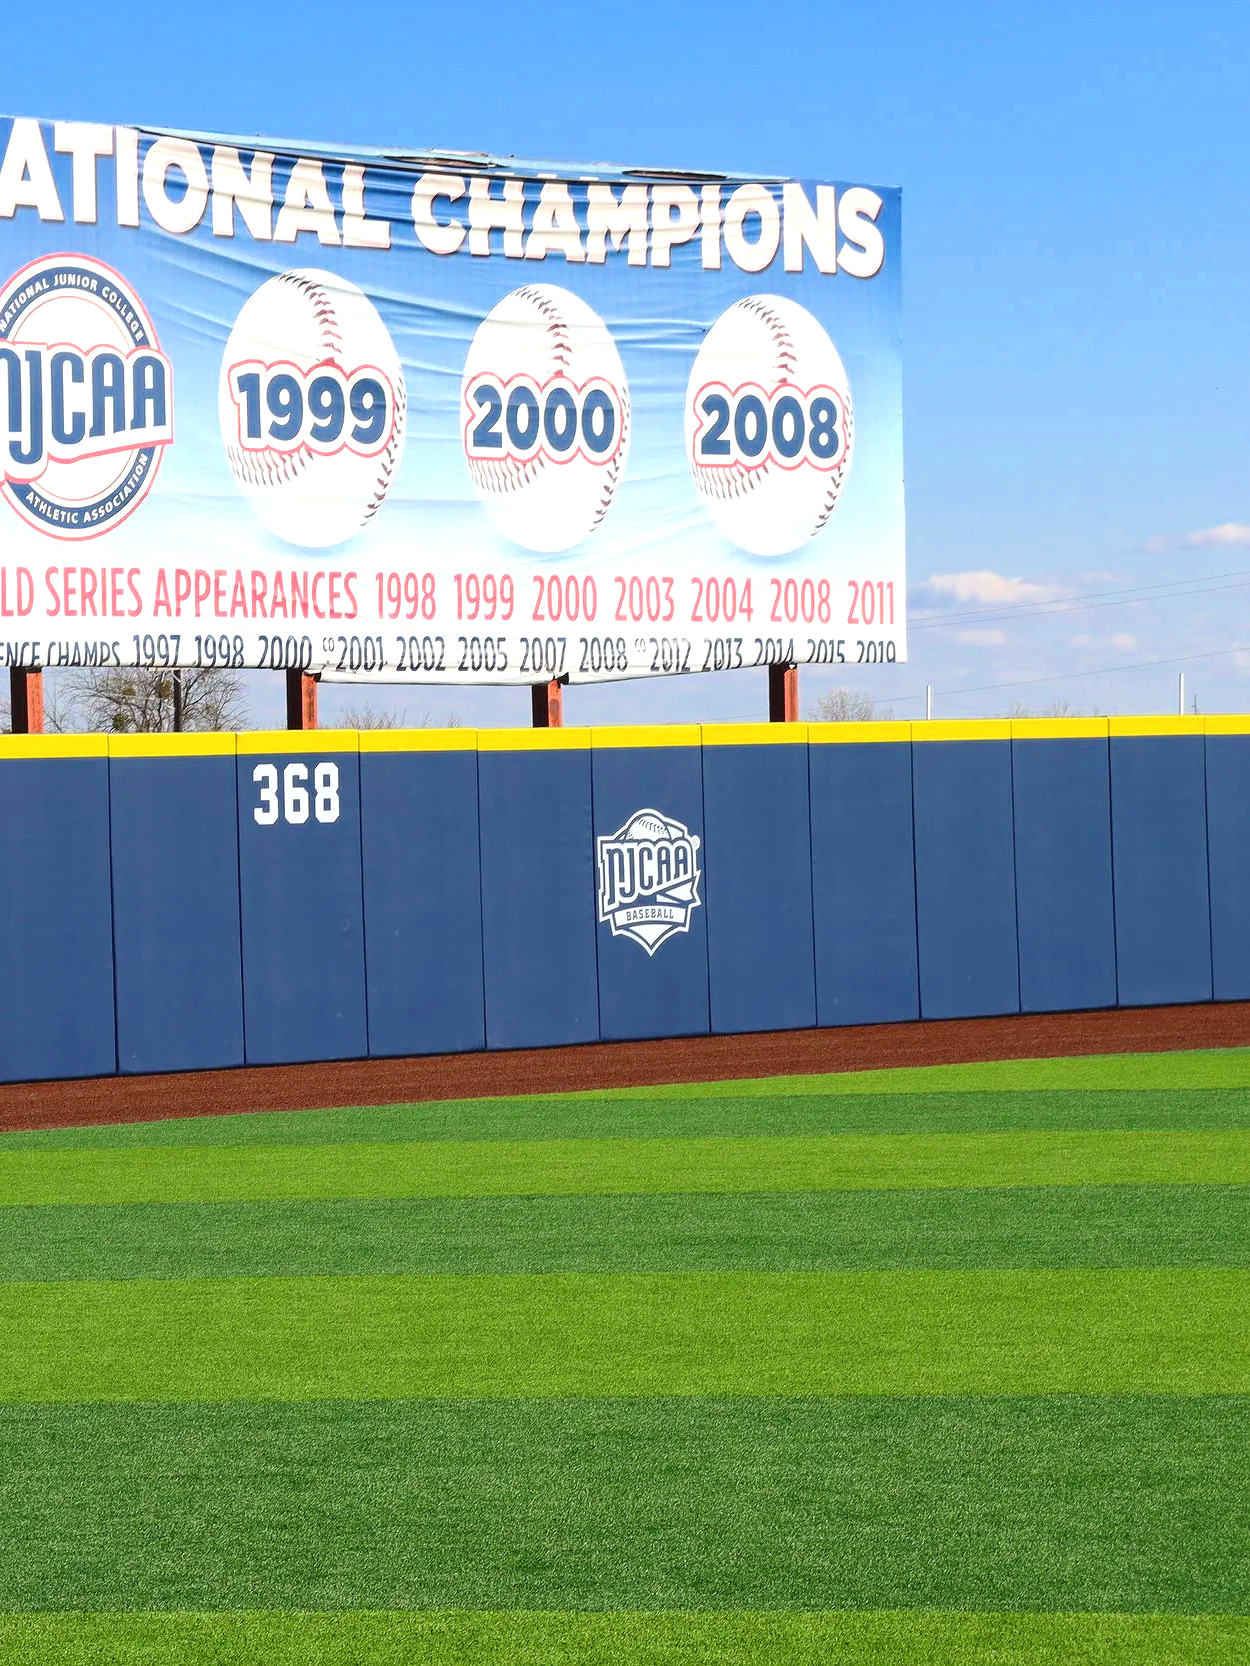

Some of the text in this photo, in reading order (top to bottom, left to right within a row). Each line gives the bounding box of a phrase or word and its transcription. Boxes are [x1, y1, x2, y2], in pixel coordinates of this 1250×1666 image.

[411, 166, 884, 278] CHAMPIONS
[53, 273, 98, 291] JUNIOR
[102, 287, 145, 342] COLLEGE
[237, 372, 387, 445] 1999
[472, 384, 615, 453] 2000
[701, 393, 839, 459] 2008
[25, 453, 149, 524] ATHLETIC ASSOCIATION
[46, 566, 143, 618] SERIES
[153, 568, 358, 620] APPEARANCES
[375, 572, 436, 622] 1998
[454, 573, 514, 622] 1999
[532, 575, 598, 623] 2000
[614, 575, 674, 623] 2003
[690, 576, 754, 624] 2004
[770, 578, 832, 625] 2008
[847, 580, 895, 626] 2011
[47, 641, 121, 667] CHAMPS
[132, 634, 181, 667] 1997
[194, 634, 245, 668] 1998
[257, 635, 313, 670] 2000
[336, 635, 384, 672] 2001
[396, 636, 447, 672] 2002
[458, 636, 508, 672] 2005
[520, 637, 567, 673] 2007
[579, 637, 629, 673] 2008
[649, 637, 691, 673] 2012
[702, 637, 743, 672] 2013
[754, 637, 794, 666] 2014
[807, 638, 846, 663] 2015
[252, 762, 340, 825] 368
[606, 845, 688, 907] NJCAA
[626, 908, 674, 921] BASEBALL
